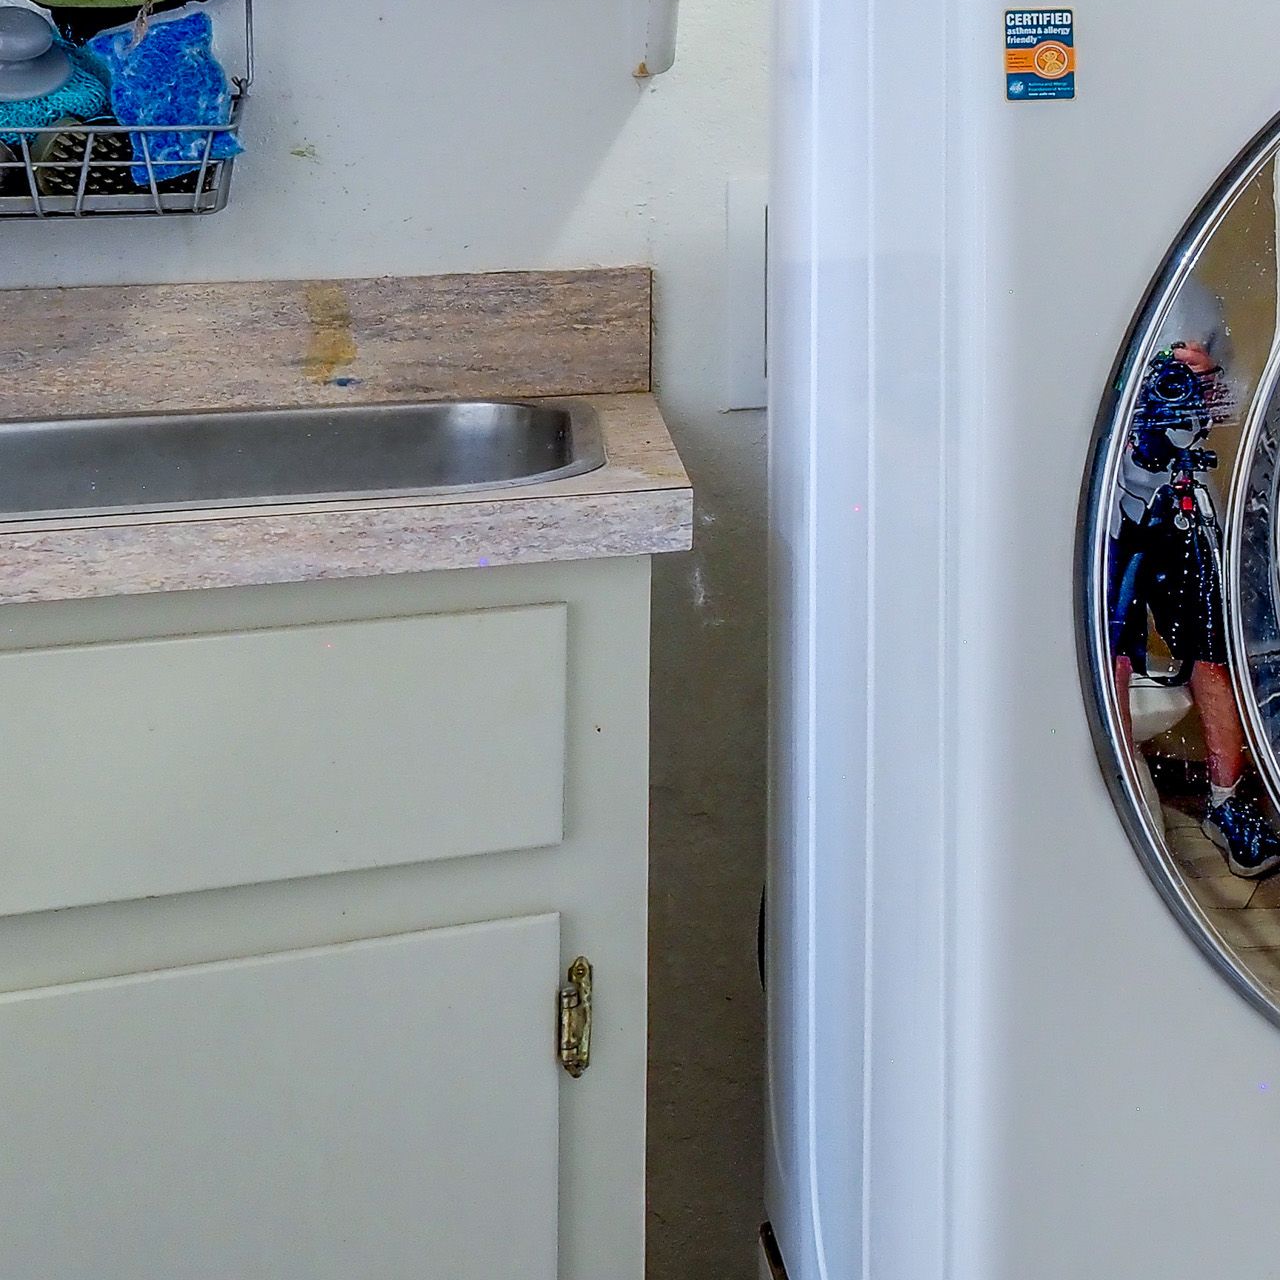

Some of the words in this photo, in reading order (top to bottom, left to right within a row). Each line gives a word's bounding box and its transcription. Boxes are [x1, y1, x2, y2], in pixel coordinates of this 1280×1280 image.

[1006, 12, 1072, 26] CERTIFIED
[1007, 26, 1036, 35] asthma
[1037, 27, 1043, 35] &
[1043, 26, 1071, 35] allergy
[1007, 36, 1038, 45] friendly
